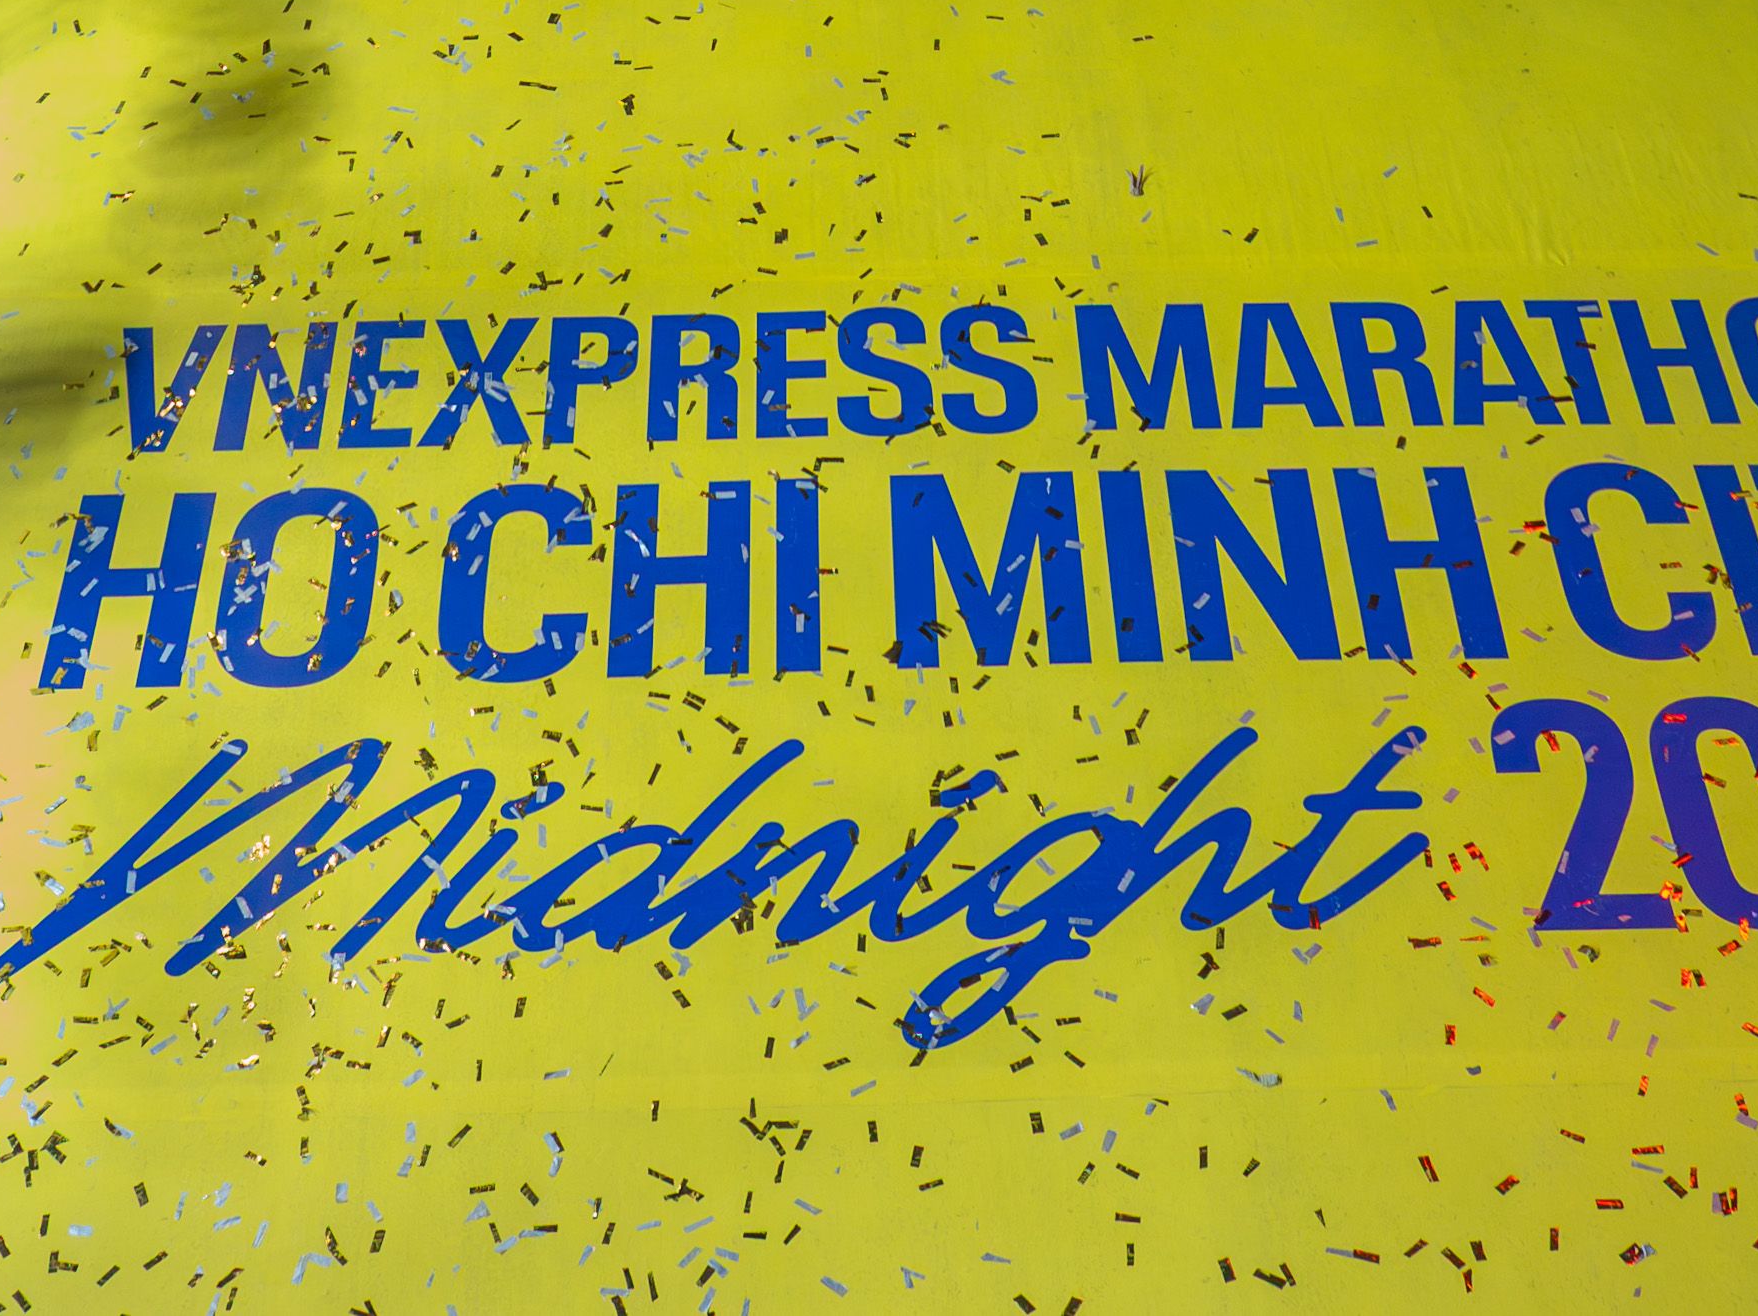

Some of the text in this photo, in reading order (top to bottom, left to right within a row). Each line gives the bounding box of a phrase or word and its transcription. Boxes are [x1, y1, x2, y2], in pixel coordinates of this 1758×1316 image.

[117, 306, 1044, 454] VNEXPRESS
[42, 481, 379, 691] HO
[433, 468, 824, 680] CHI
[889, 463, 1511, 673] MINH
